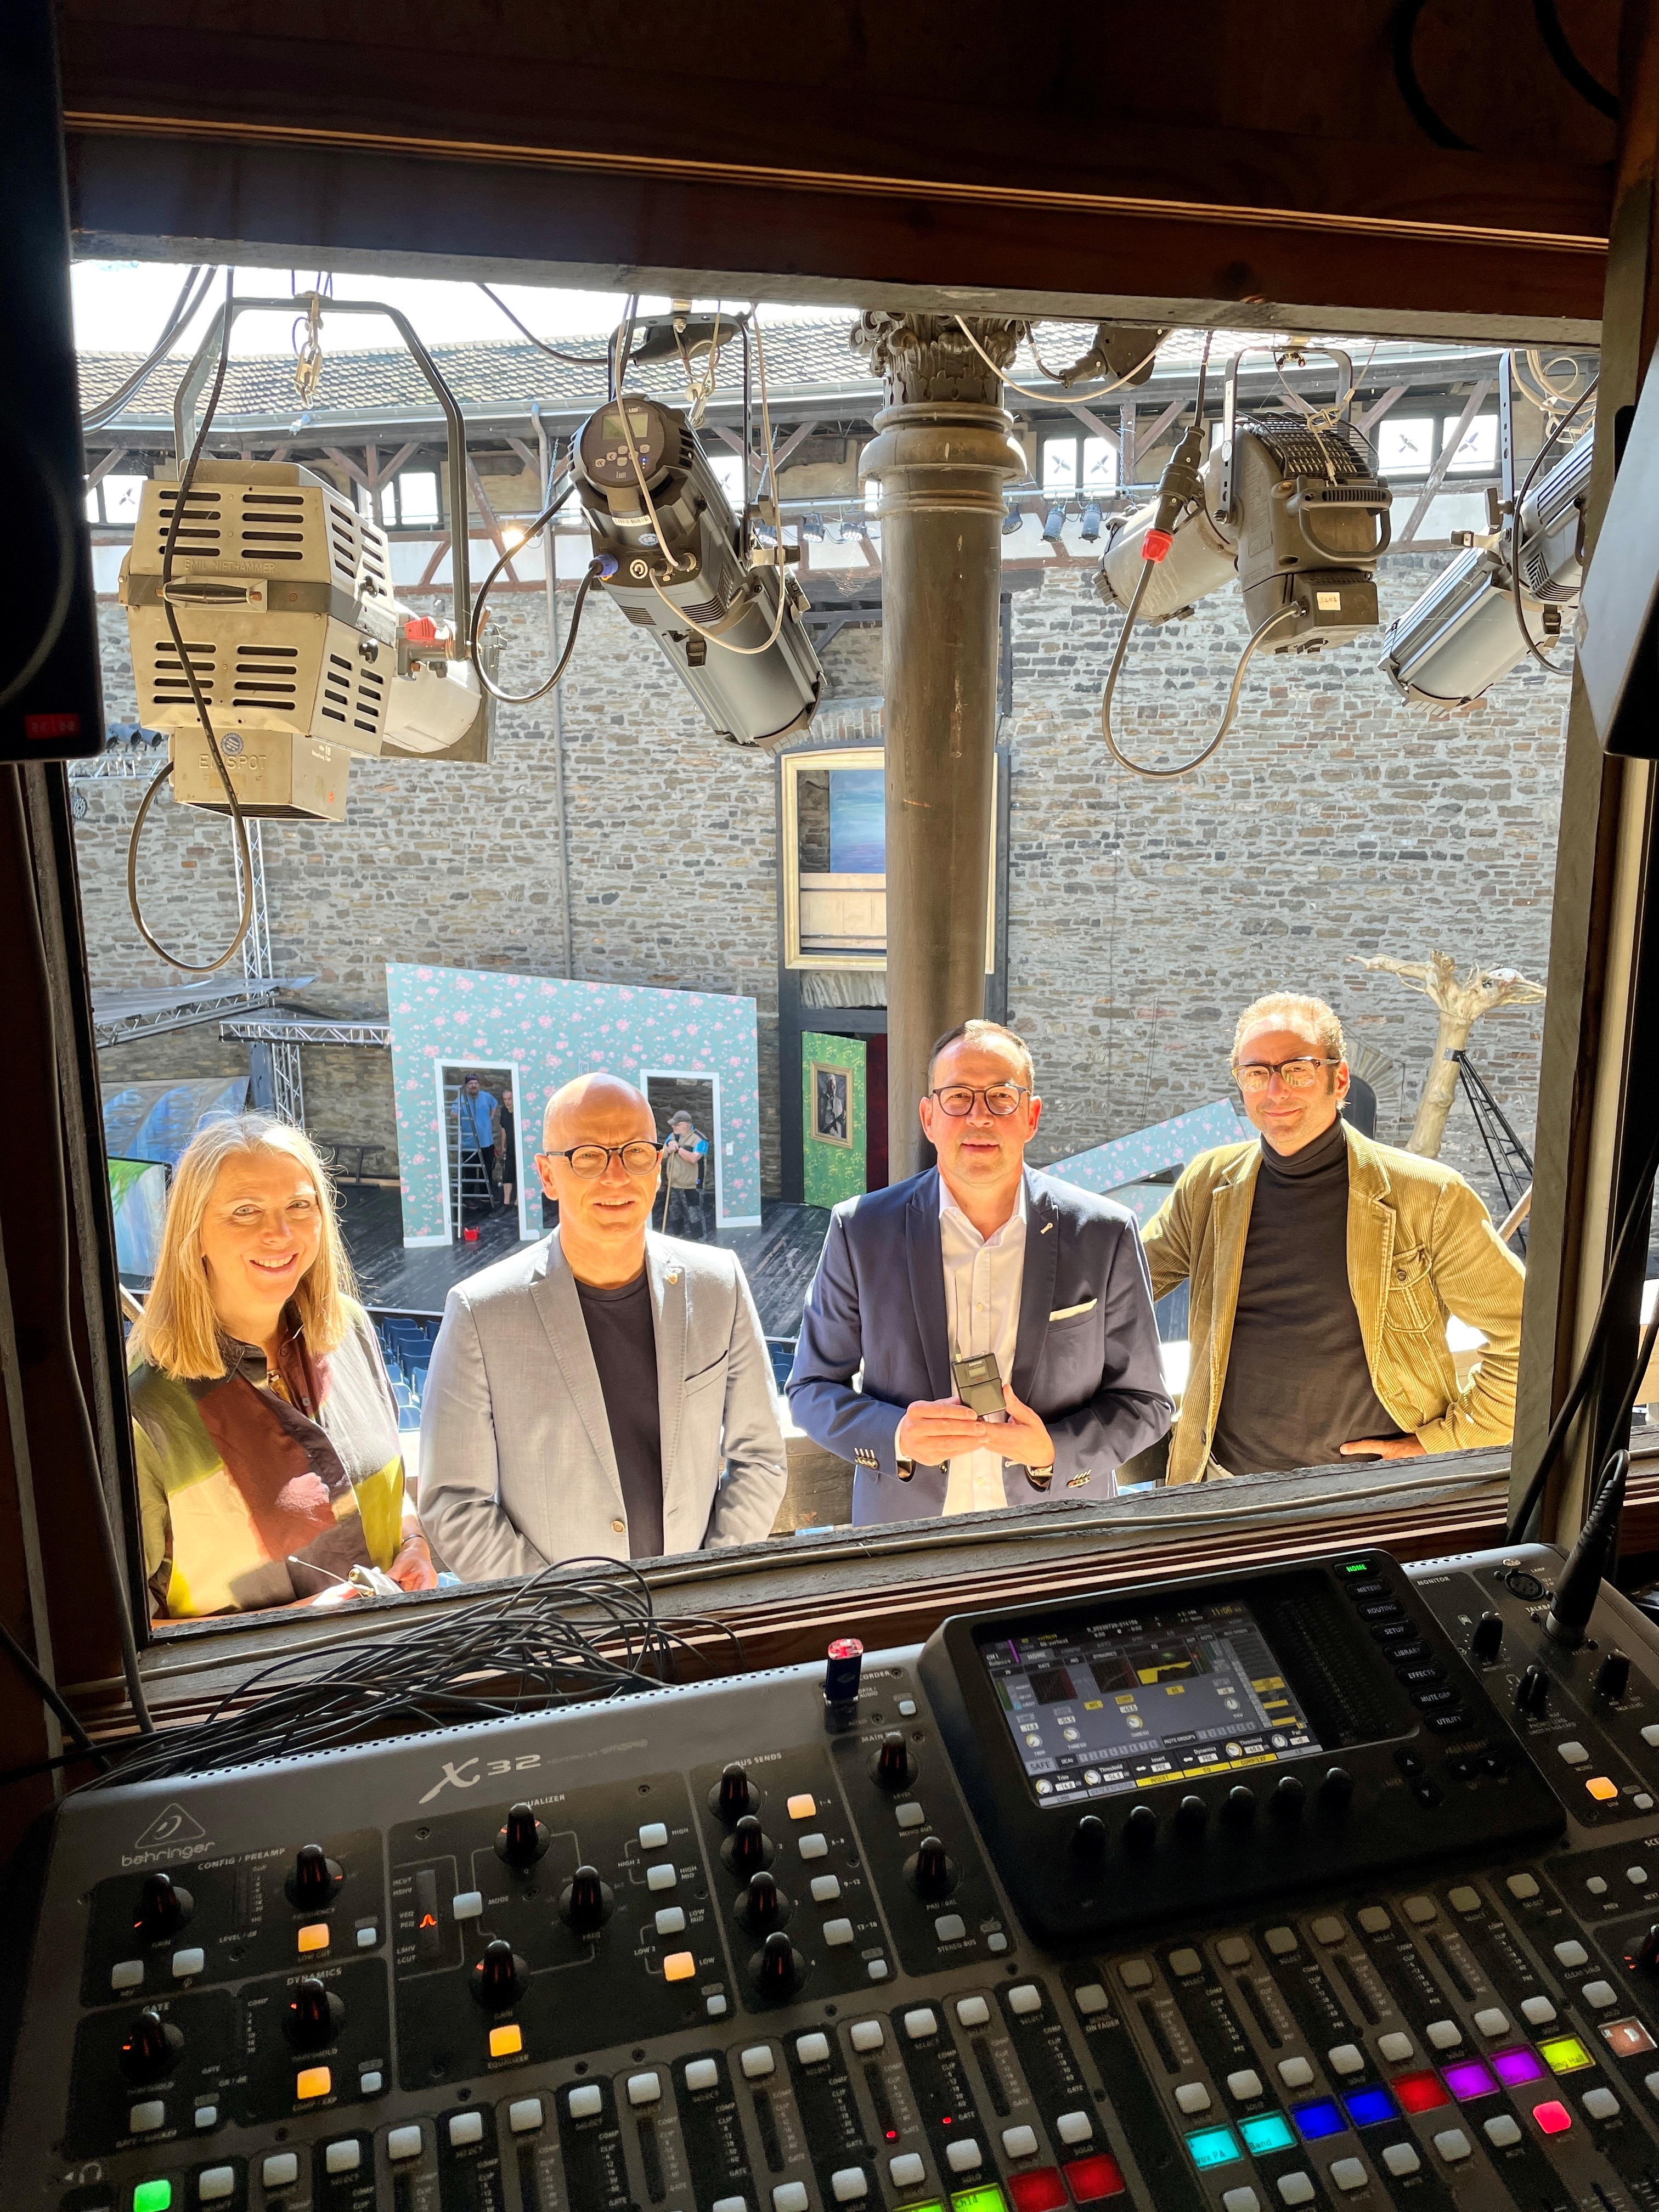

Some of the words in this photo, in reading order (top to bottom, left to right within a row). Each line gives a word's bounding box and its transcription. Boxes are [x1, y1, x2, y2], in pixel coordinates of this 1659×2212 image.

[184, 559, 206, 570] EMIL
[213, 560, 275, 573] NIETHAMMER
[1346, 1564, 1367, 1572] HOME
[1417, 1576, 1450, 1585] MONITOR
[1356, 1584, 1382, 1593] METERS
[1367, 1604, 1397, 1615] ROUTING
[1525, 1603, 1552, 1613] TALKBA
[1384, 1627, 1404, 1635] SETUP
[1394, 1647, 1421, 1657] LIBRARY
[1408, 1669, 1435, 1679] EFFECTS
[1420, 1694, 1438, 1703] MUTE
[1436, 1716, 1462, 1726] UTILITY
[861, 1734, 883, 1743] MAIN
[754, 1752, 782, 1764] SENDS
[418, 1753, 542, 1805] X32
[527, 1794, 565, 1807] UALIZER
[672, 1827, 689, 1836] HIGH
[121, 1841, 215, 1867] behringer
[197, 1858, 235, 1871] CONFIG
[245, 1847, 285, 1862] PREAMP
[680, 1865, 697, 1874] HIGH
[633, 1946, 650, 1956] LOW
[699, 1956, 714, 1966] LOW
[1043, 2024, 1062, 2033] COMP
[938, 2050, 957, 2059] COMP
[1570, 2054, 1585, 2064] Hall
[828, 2076, 848, 2085] COMP
[1248, 2138, 1272, 2151] Band
[1212, 2150, 1226, 2160] PA
